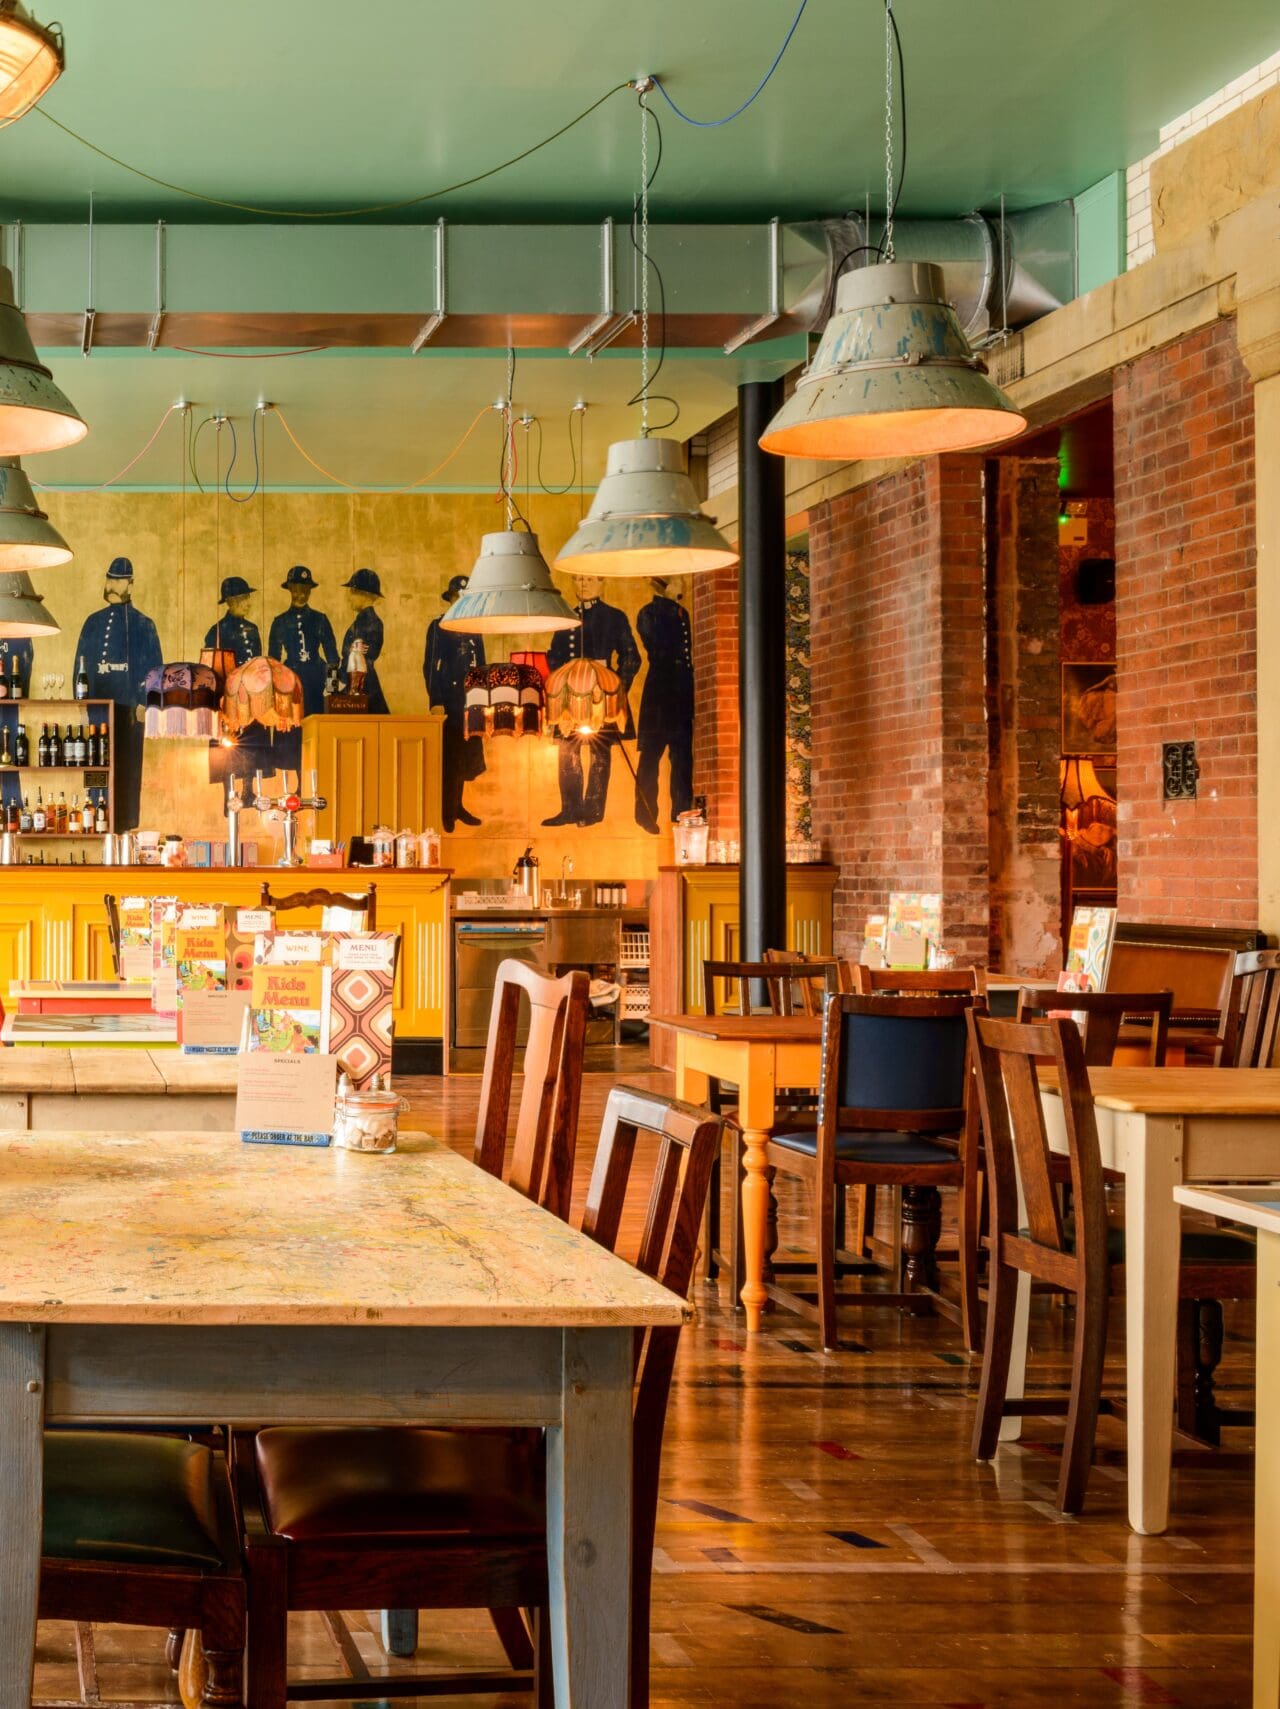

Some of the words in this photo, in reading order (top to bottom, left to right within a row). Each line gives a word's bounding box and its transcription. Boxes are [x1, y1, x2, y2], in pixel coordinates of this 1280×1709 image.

[186, 937, 214, 948] Kids
[350, 944, 377, 952] MENU
[183, 948, 218, 958] Menu
[286, 945, 310, 953] WINE
[267, 976, 306, 991] Kids
[262, 991, 310, 1006] Menu
[251, 1131, 268, 1140] PLEASE
[270, 1132, 286, 1141] ORDER
[286, 1133, 292, 1141] AT
[294, 1133, 303, 1141] THE
[303, 1134, 314, 1142] BAR
